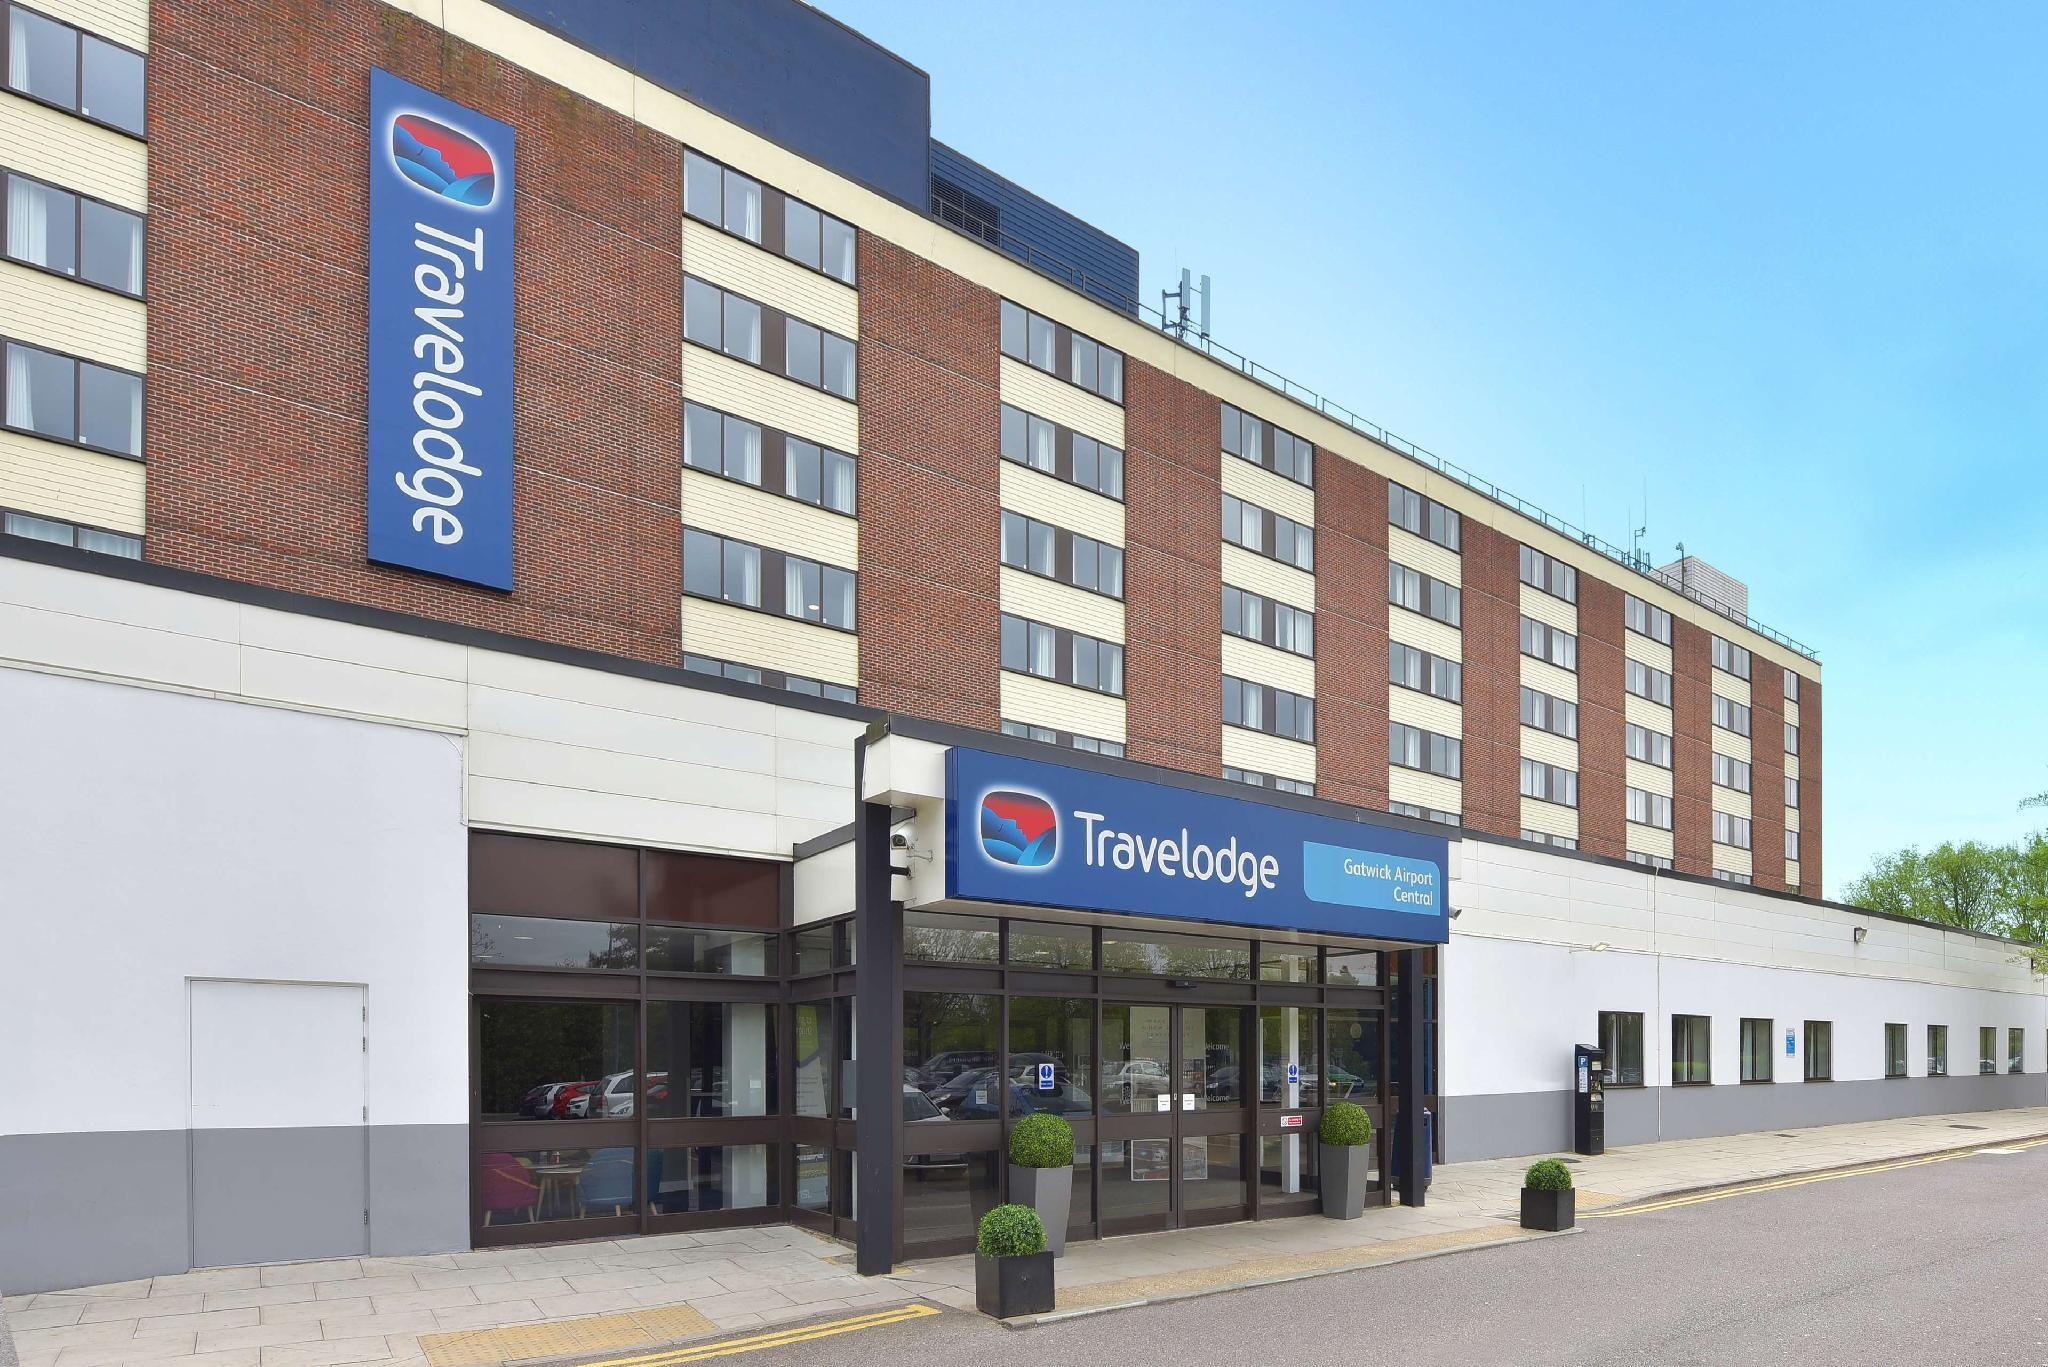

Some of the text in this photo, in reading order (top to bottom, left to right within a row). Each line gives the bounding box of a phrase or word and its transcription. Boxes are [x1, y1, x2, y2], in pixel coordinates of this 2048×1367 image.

[395, 222, 483, 545] Travelodge
[1073, 810, 1279, 898] Travelodge
[1343, 858, 1433, 887] Gatwick Airport
[1393, 886, 1433, 906] Central
